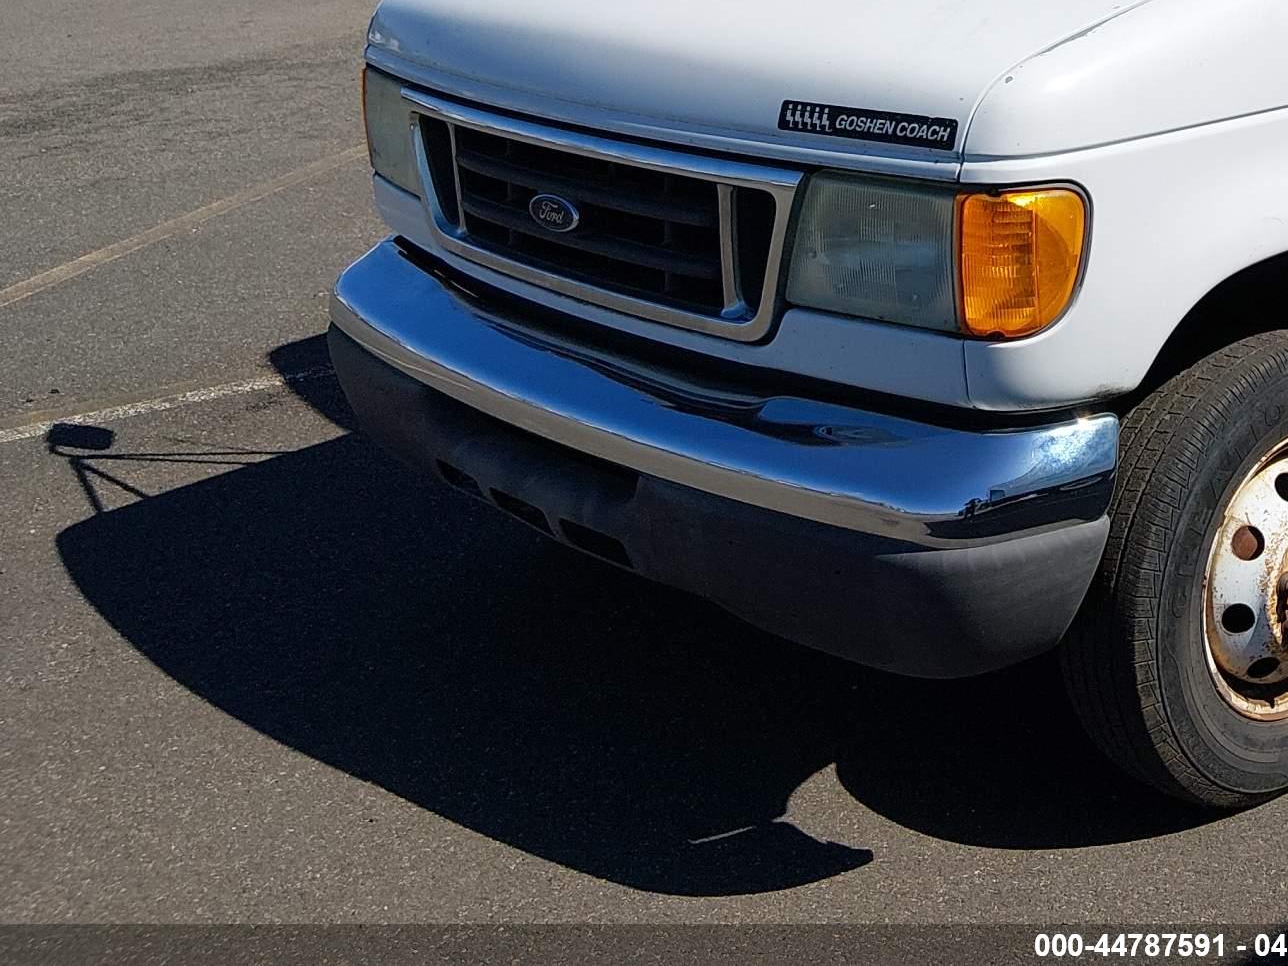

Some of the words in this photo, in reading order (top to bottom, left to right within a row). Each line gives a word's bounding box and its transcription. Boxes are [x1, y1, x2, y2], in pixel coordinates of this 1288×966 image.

[835, 115, 896, 135] GOSHEN
[896, 122, 951, 142] COACH
[539, 201, 565, 224] Ford
